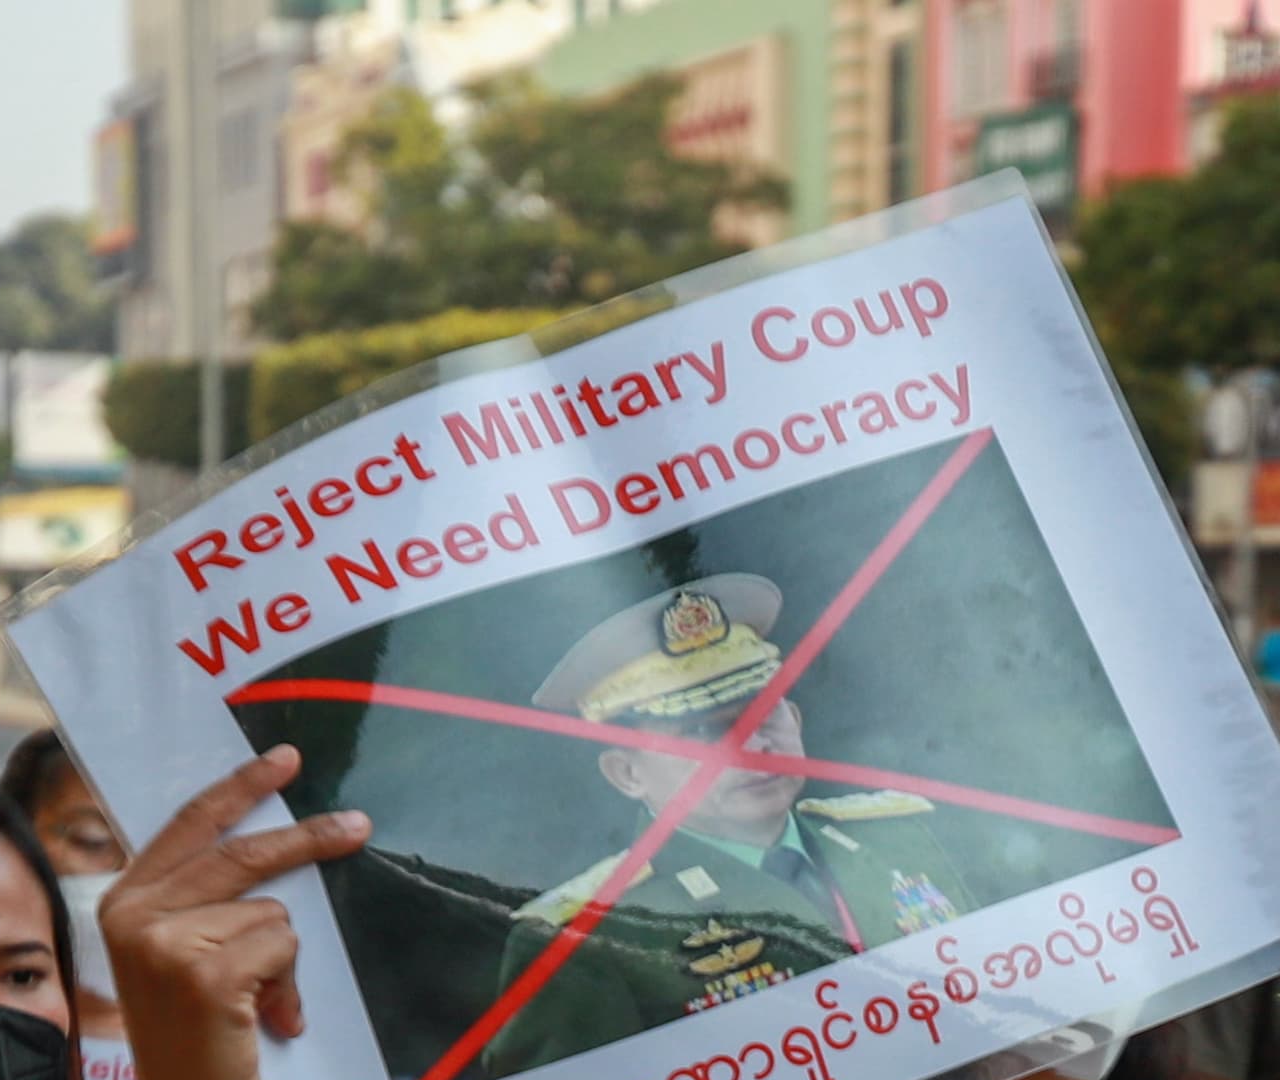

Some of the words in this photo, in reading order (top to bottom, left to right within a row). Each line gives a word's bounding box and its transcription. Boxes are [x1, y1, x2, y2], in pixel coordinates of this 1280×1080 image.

[174, 434, 436, 592] Reject
[445, 342, 726, 467] Military
[752, 277, 949, 362] Coup
[176, 593, 312, 677] We
[325, 497, 540, 604] Need
[550, 365, 972, 535] Democracy
